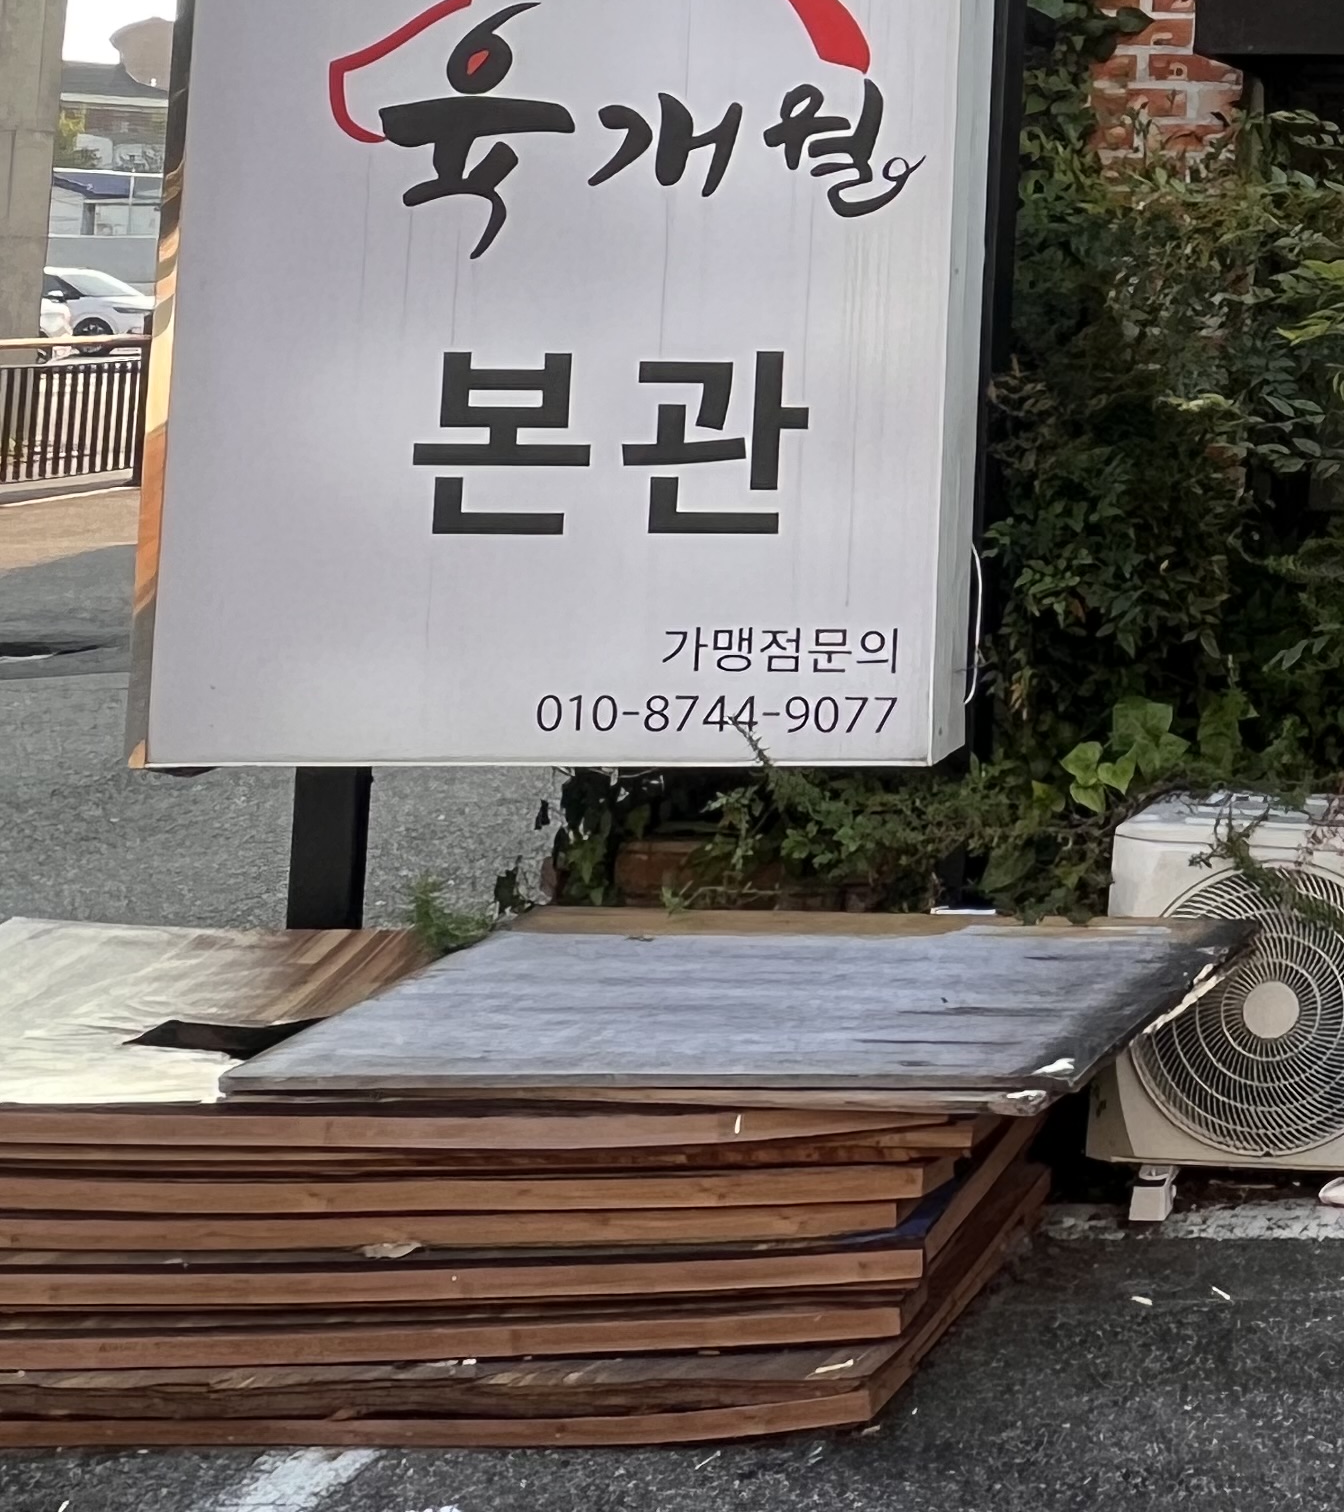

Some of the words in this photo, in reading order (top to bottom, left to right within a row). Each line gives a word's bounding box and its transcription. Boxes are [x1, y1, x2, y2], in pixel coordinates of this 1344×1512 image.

[379, 2, 926, 260] 육개월
[413, 351, 810, 536] 본관
[663, 627, 899, 674] 가맹점문의
[537, 695, 898, 734] 010-8744-9077
